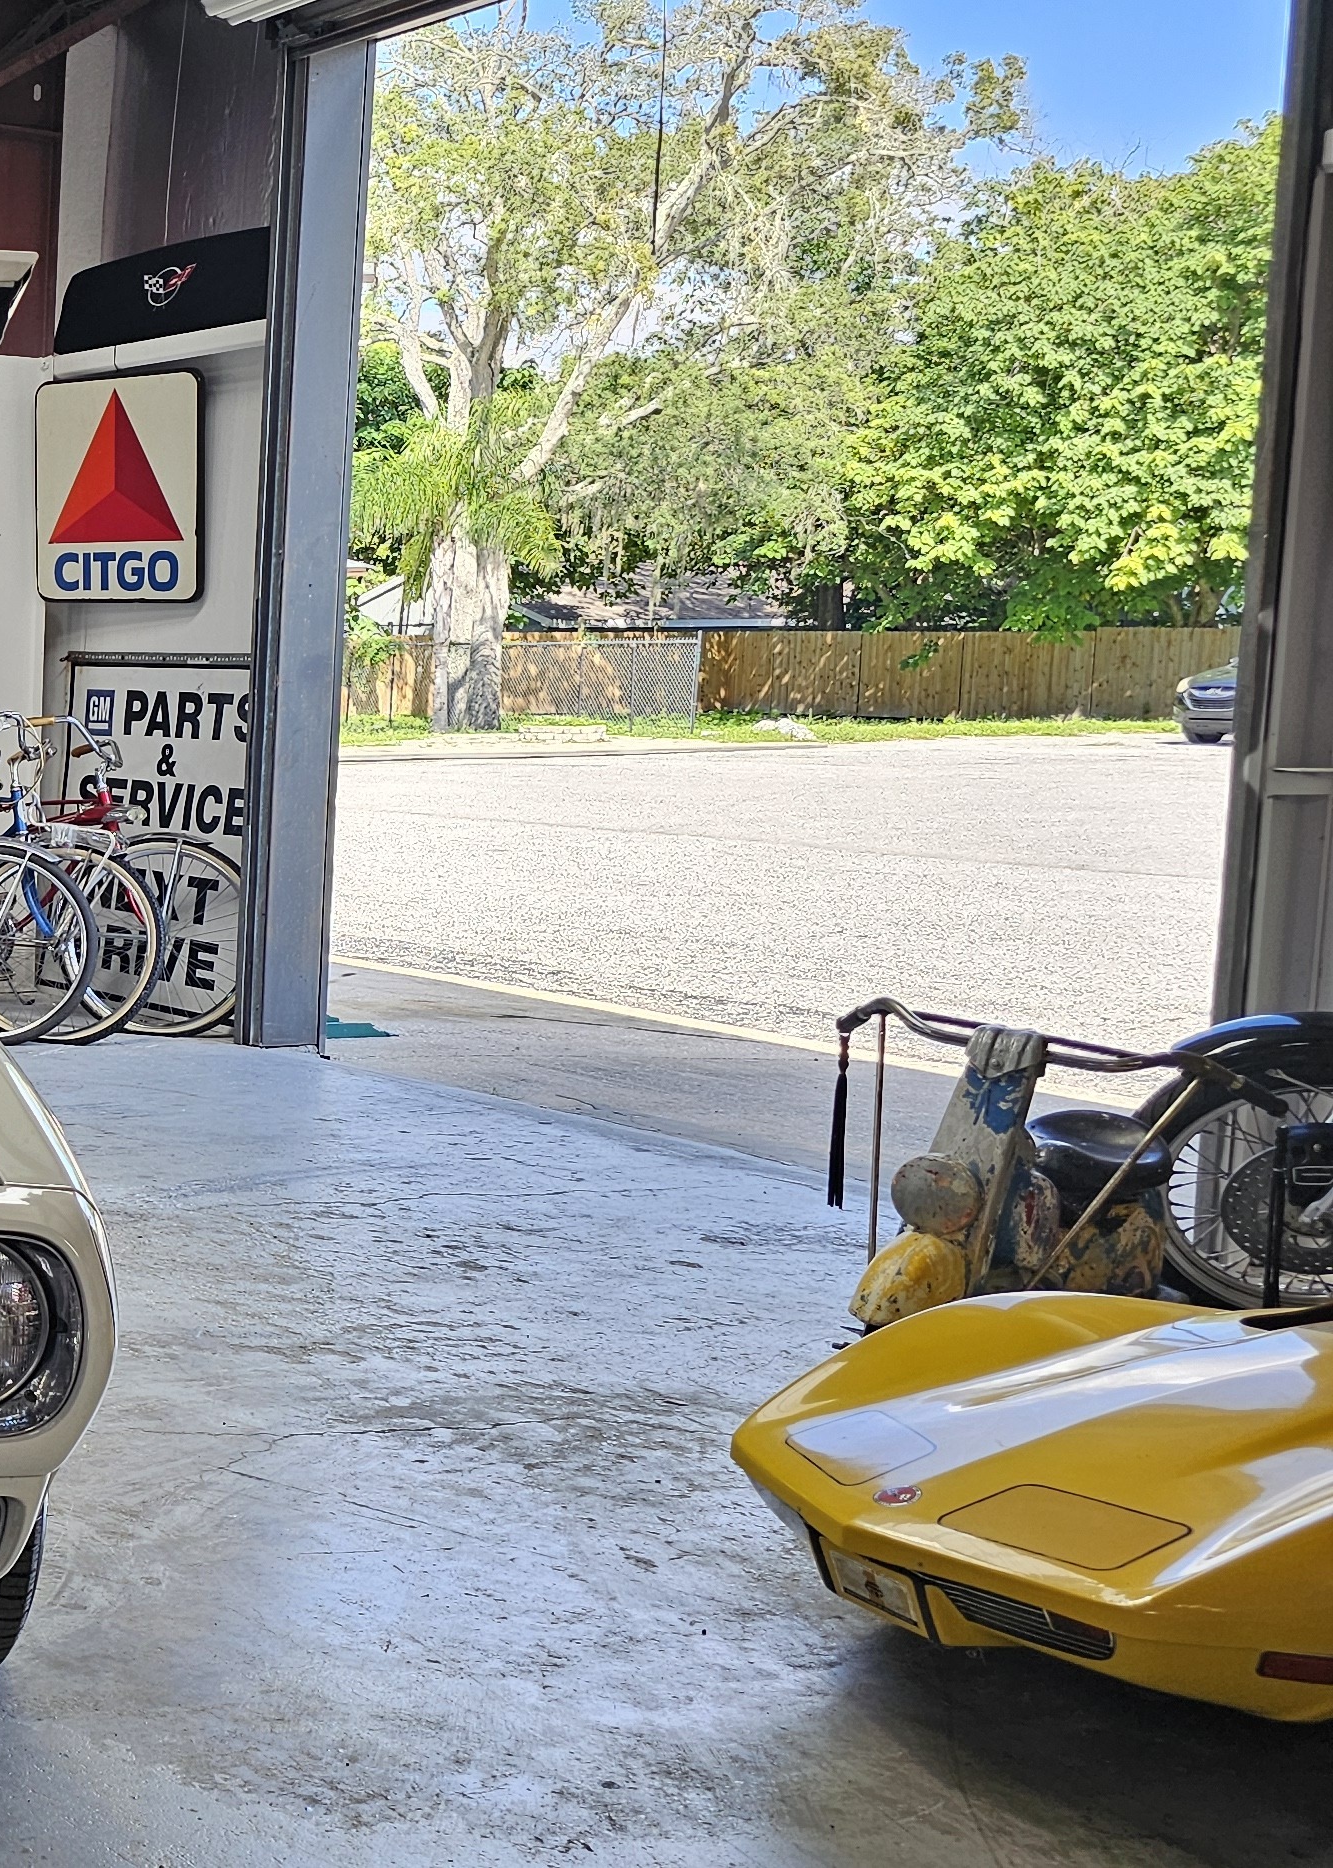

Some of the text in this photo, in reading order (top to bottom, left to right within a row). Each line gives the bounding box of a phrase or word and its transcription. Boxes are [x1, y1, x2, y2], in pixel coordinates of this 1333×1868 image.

[53, 550, 180, 593] CITGO
[89, 689, 250, 744] GM PARTS
[156, 743, 176, 777] &
